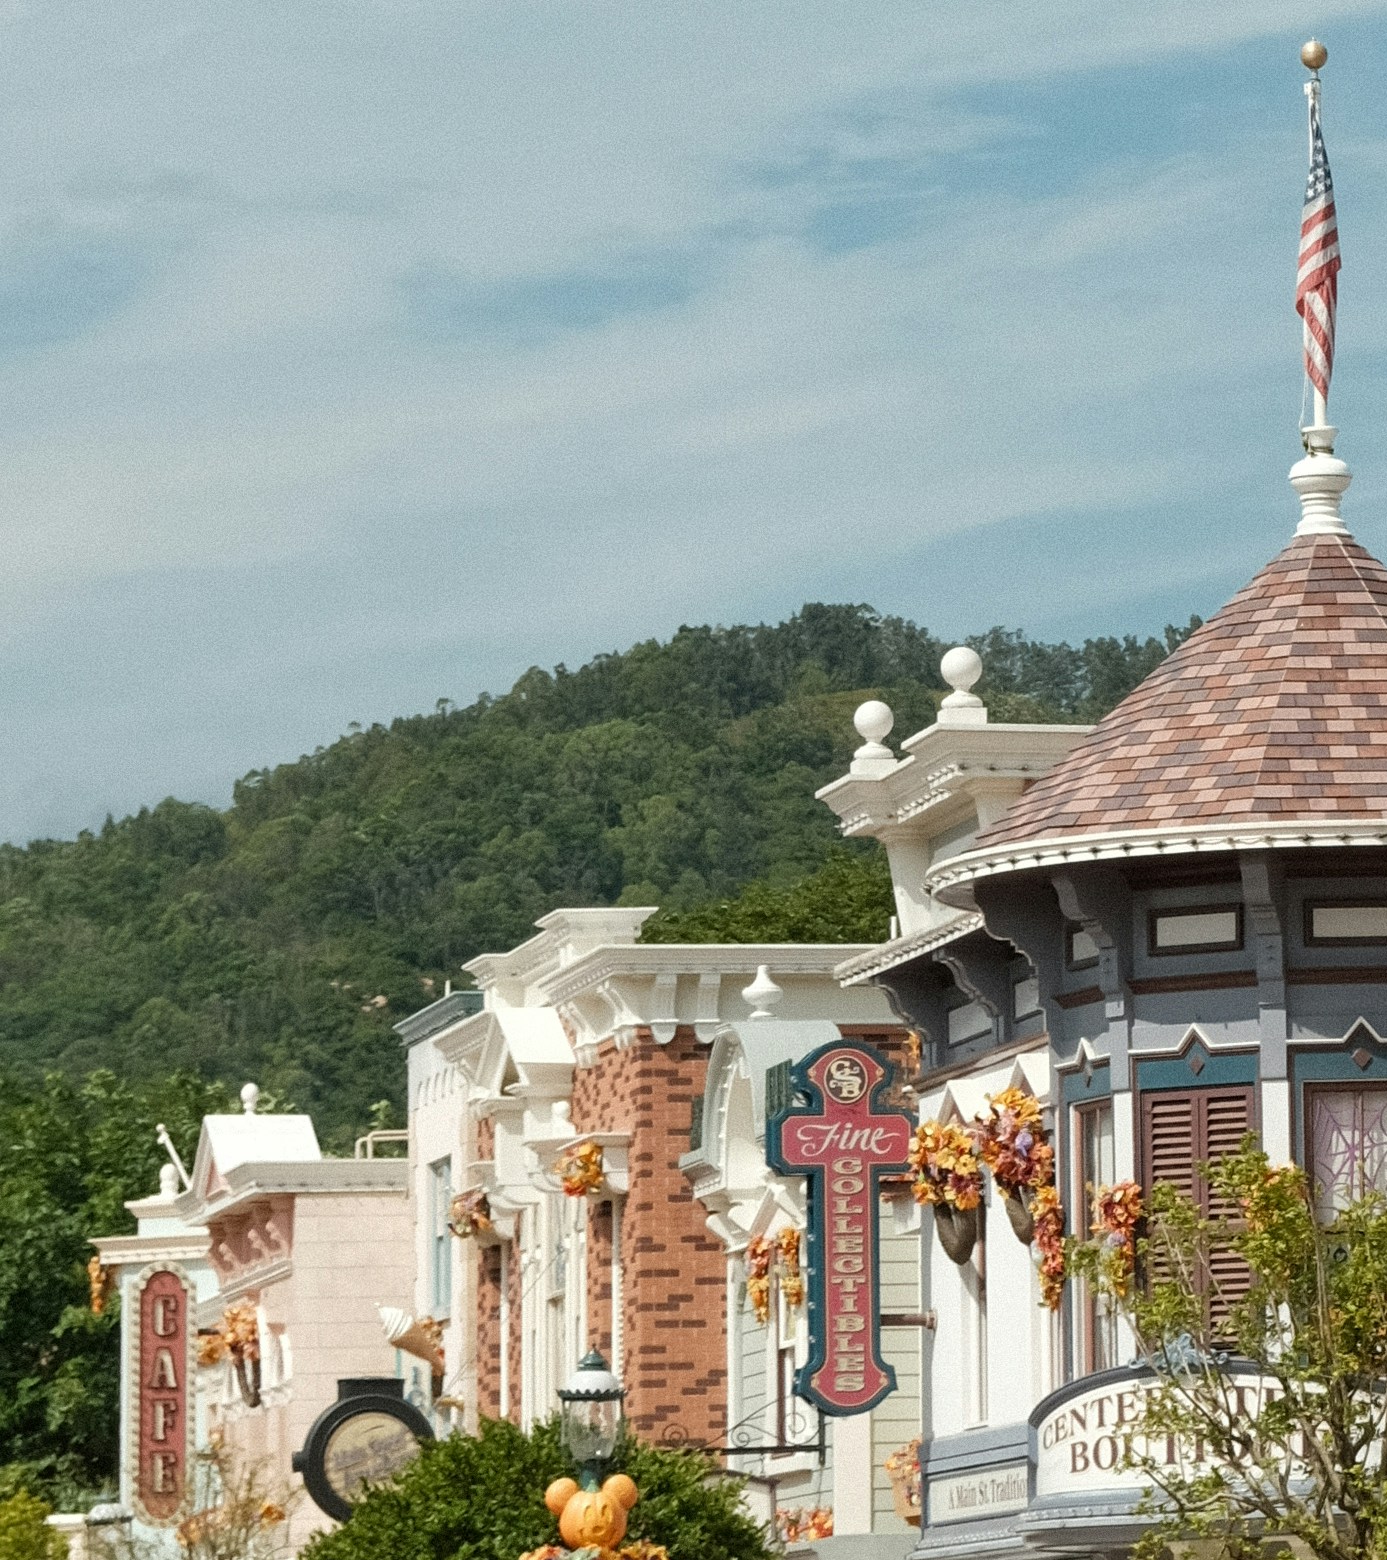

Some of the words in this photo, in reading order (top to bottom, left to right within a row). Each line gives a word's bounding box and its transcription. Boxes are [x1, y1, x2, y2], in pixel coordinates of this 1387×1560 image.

[797, 1121, 901, 1157] Fine
[832, 1157, 865, 1393] COLLECTIBLES
[150, 1294, 179, 1494] CAFE
